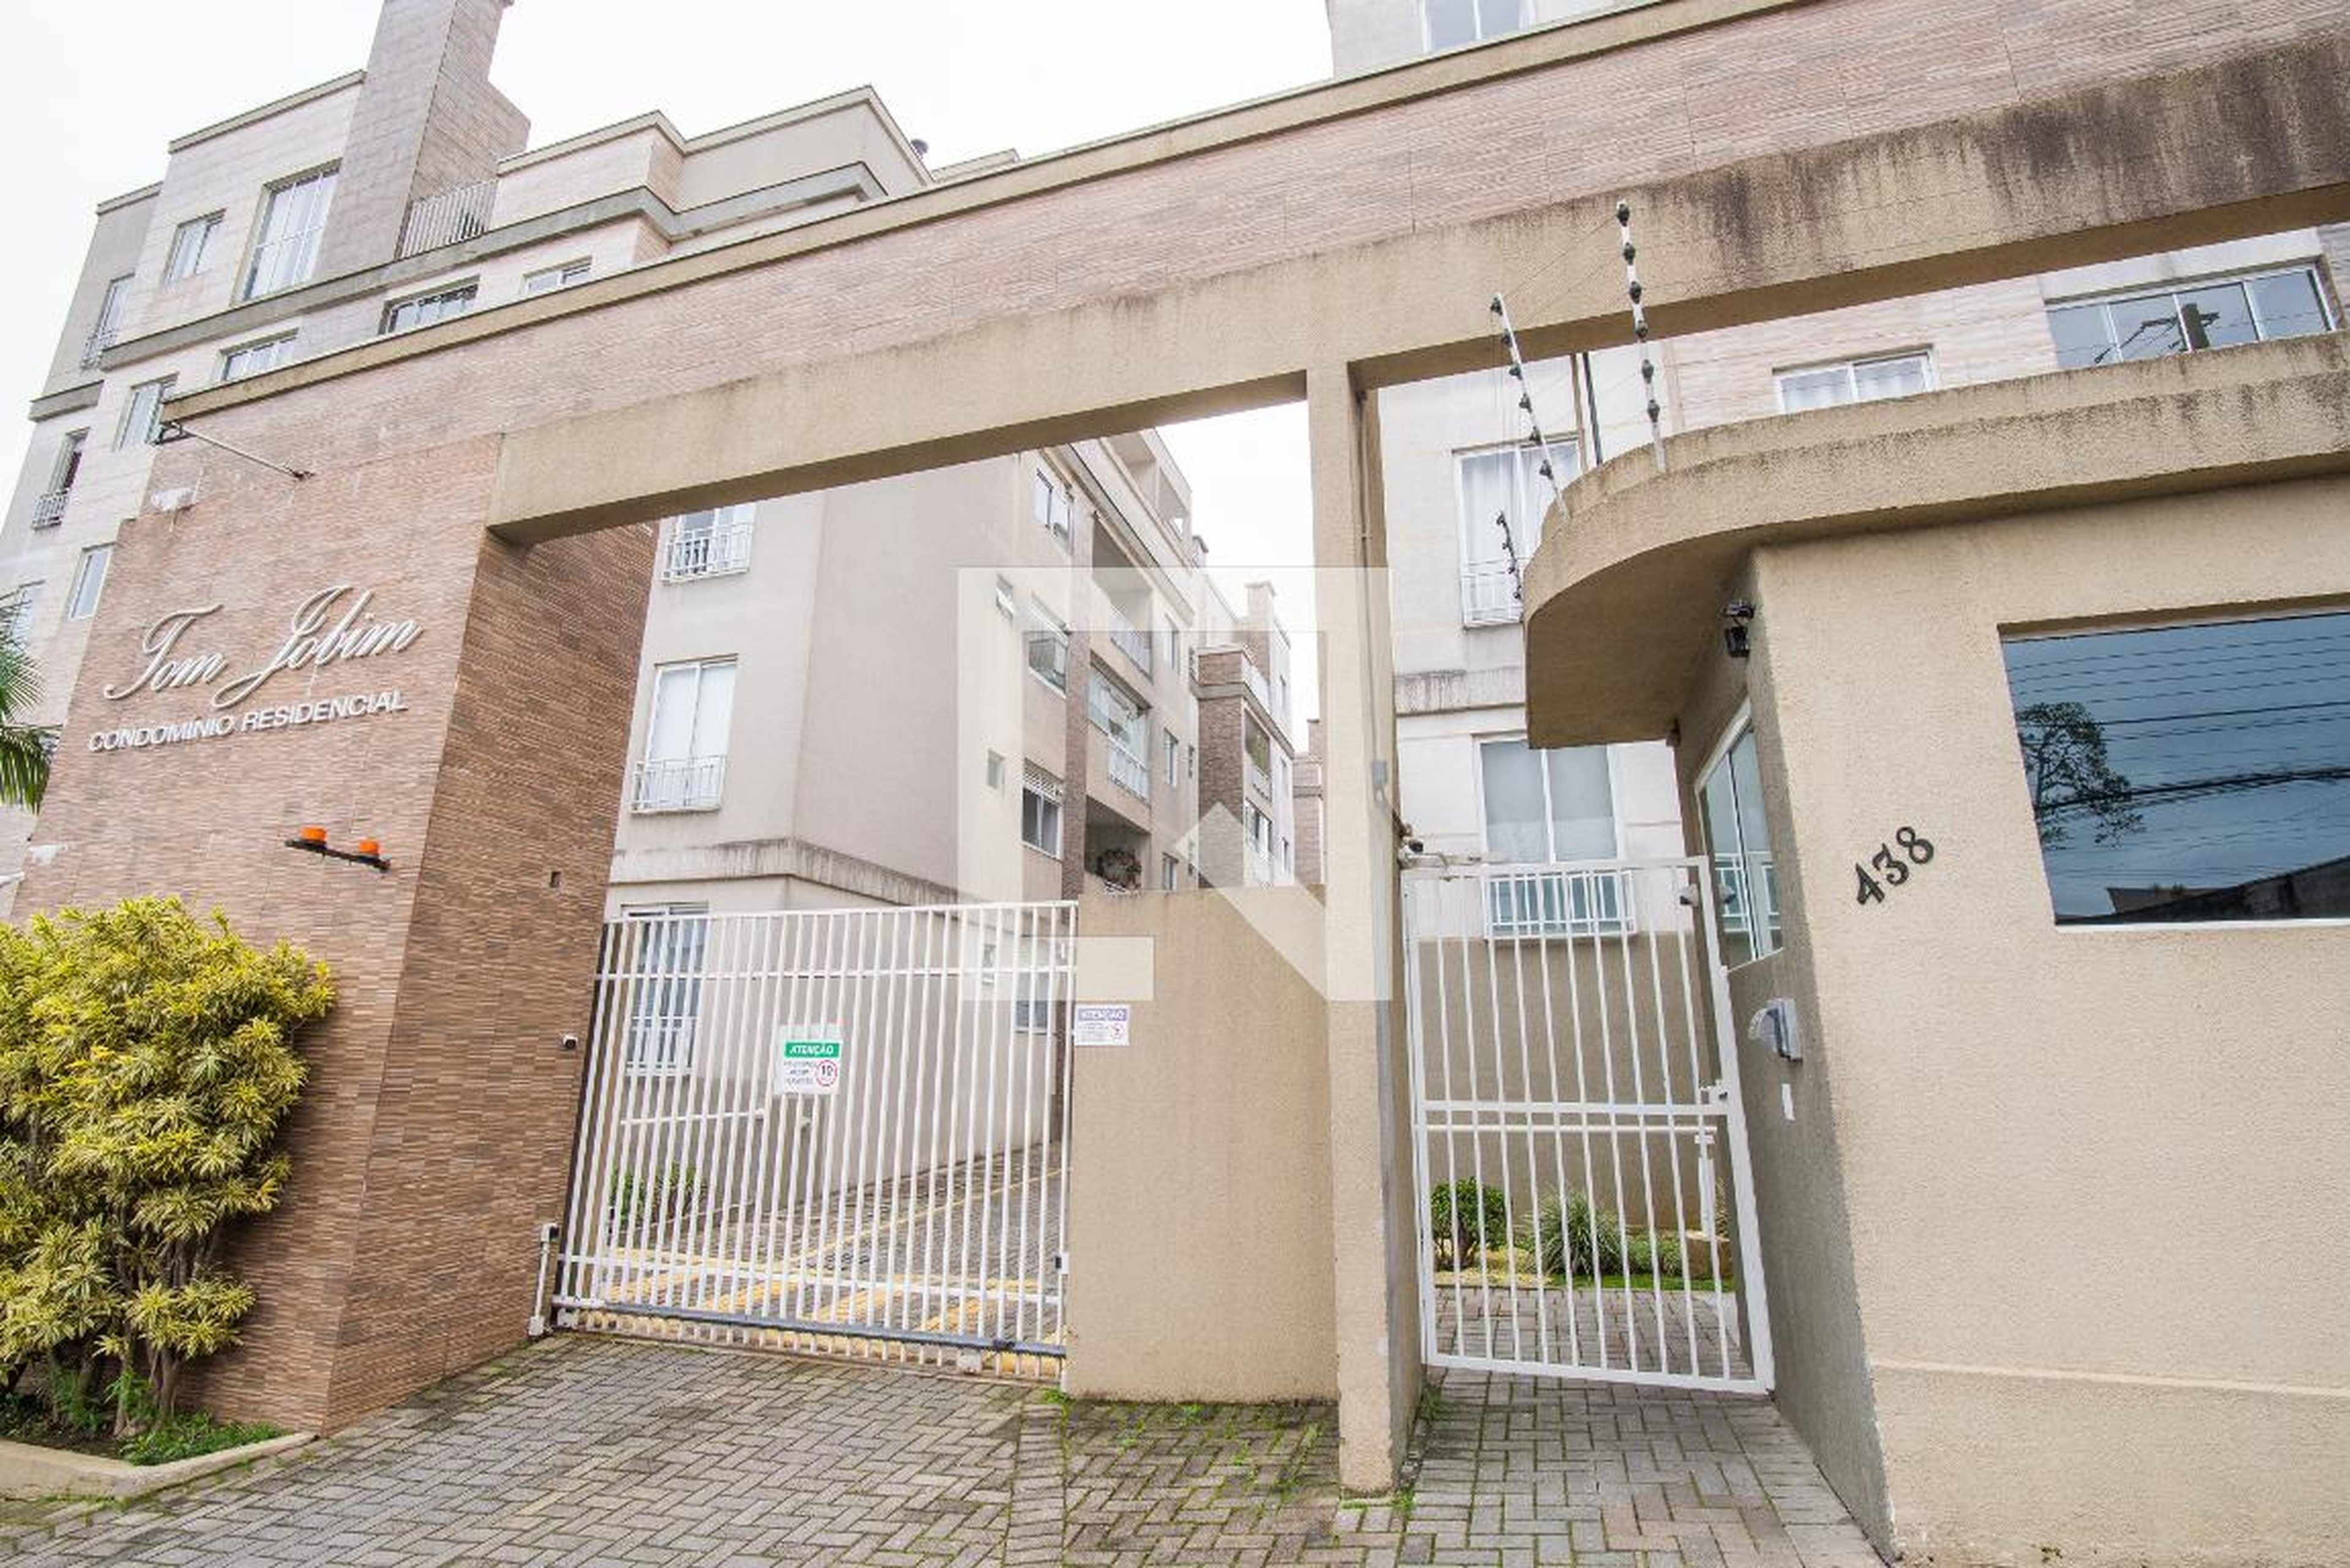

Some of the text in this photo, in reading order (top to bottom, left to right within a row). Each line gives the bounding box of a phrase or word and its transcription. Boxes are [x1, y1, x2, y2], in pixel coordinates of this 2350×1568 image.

[103, 585, 425, 708] Tom Jobim
[241, 690, 409, 732] RESIDENCIAL
[1856, 826, 1934, 905] 438
